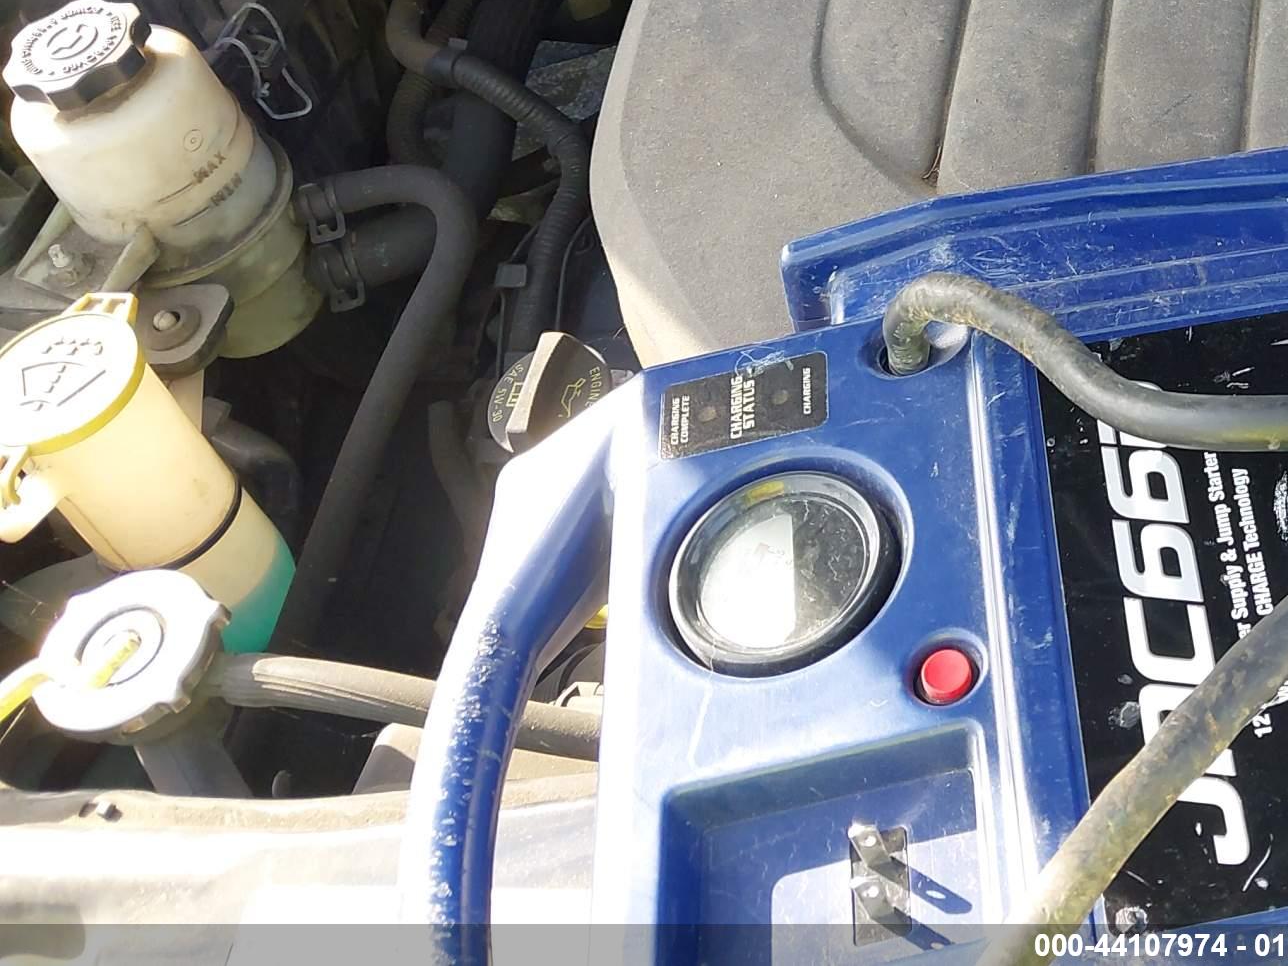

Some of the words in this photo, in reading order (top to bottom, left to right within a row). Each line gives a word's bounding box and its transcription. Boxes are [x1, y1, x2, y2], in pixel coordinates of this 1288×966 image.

[504, 364, 524, 384] SAE
[802, 367, 812, 415] CHARGING
[492, 388, 507, 422] 5W-30
[671, 398, 680, 445] CHARGING
[680, 395, 690, 443] COMPLETE
[730, 375, 743, 439] CHARGING
[743, 379, 755, 430] STATUS
[1204, 452, 1226, 502] Starter
[1214, 503, 1234, 546] Jump
[1232, 468, 1261, 552] Technology
[1220, 548, 1238, 563] &
[1226, 566, 1249, 619] Supply
[1246, 551, 1274, 616] CHARGE
